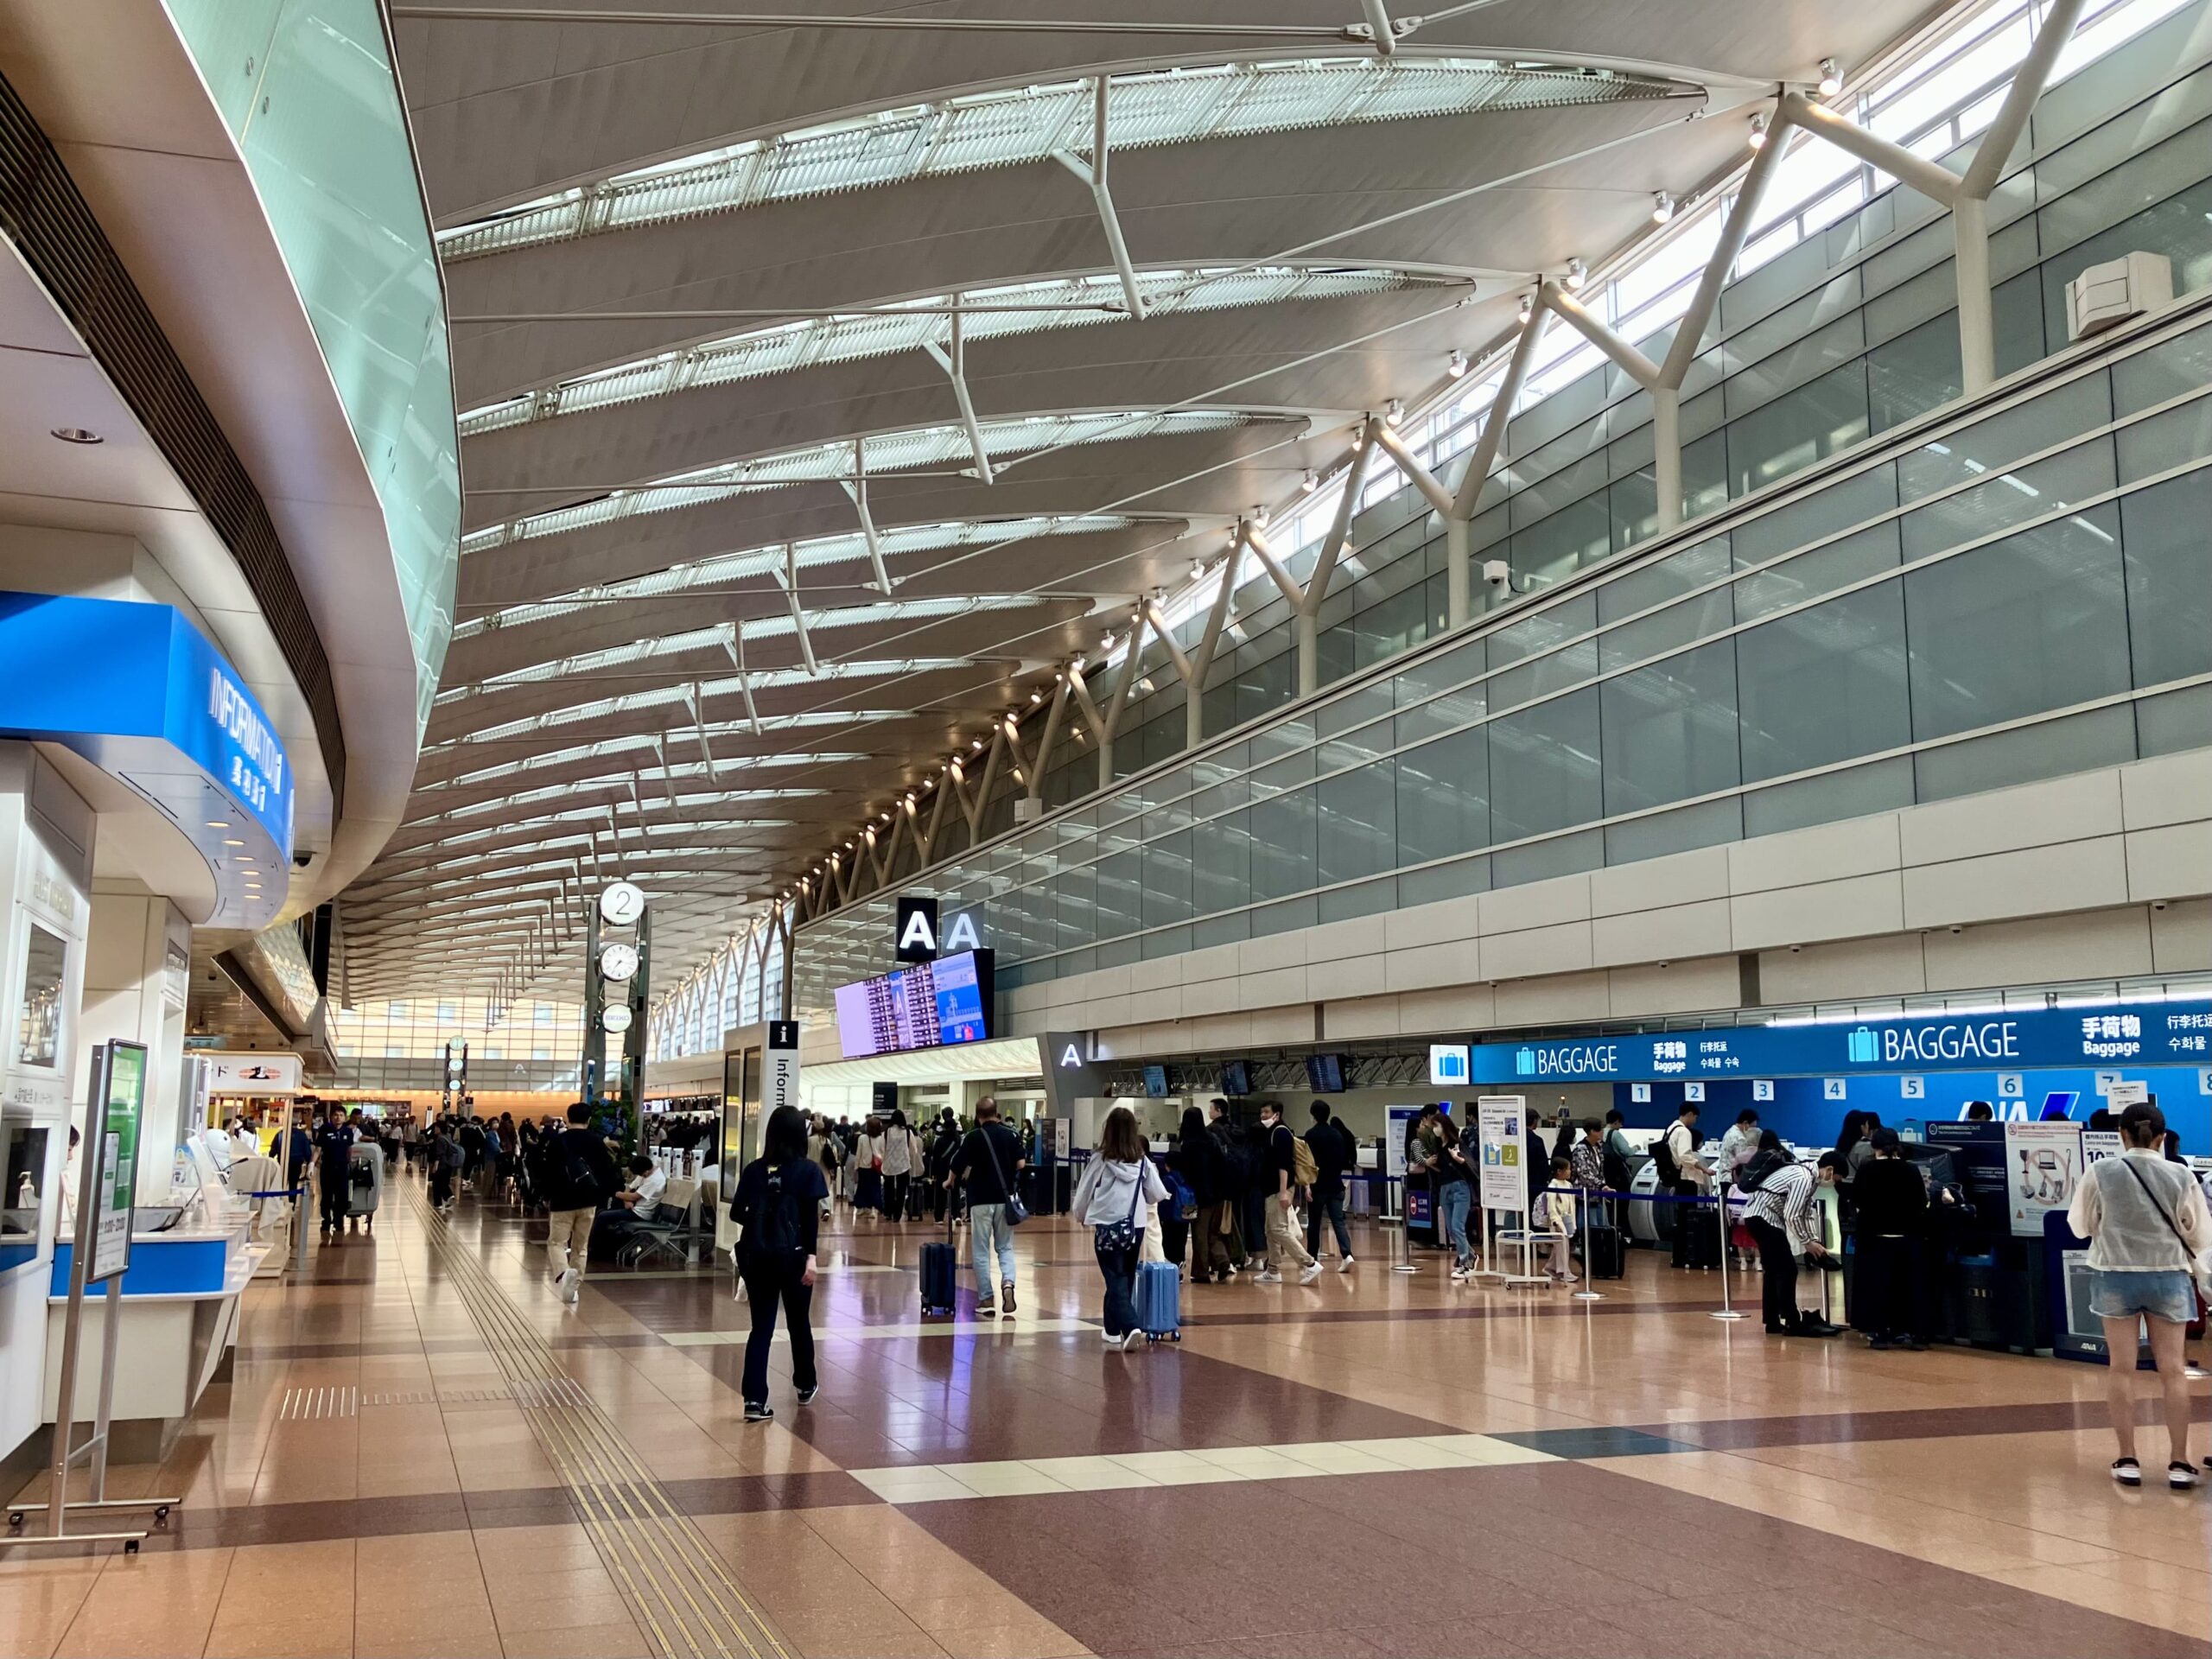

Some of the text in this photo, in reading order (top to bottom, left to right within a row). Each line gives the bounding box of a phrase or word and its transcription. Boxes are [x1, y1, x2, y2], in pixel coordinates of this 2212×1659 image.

[208, 667, 283, 795] INFORMATION
[616, 891, 631, 915] 2
[899, 911, 937, 950] A
[2082, 1014, 2141, 1039] 手荷物
[1653, 1040, 1687, 1059] 手荷物
[1700, 1041, 1727, 1052] 行李托运
[1885, 1022, 2020, 1061] BAGGAGE
[2082, 1041, 2141, 1058] Baggage
[2168, 1036, 2207, 1052] 수화물
[1060, 1044, 1082, 1067] A
[1538, 1046, 1618, 1075] BAGGAGE
[1725, 1056, 1739, 1068] 수속
[1654, 1059, 1687, 1073] Baggage
[1690, 1085, 1700, 1099] 2
[1758, 1084, 1768, 1097] 3
[1829, 1082, 1840, 1096] 4
[1907, 1080, 1918, 1095] 5
[2004, 1077, 2017, 1093] 6
[1637, 1087, 1643, 1100] 1
[2081, 1343, 2096, 1351] ANA
